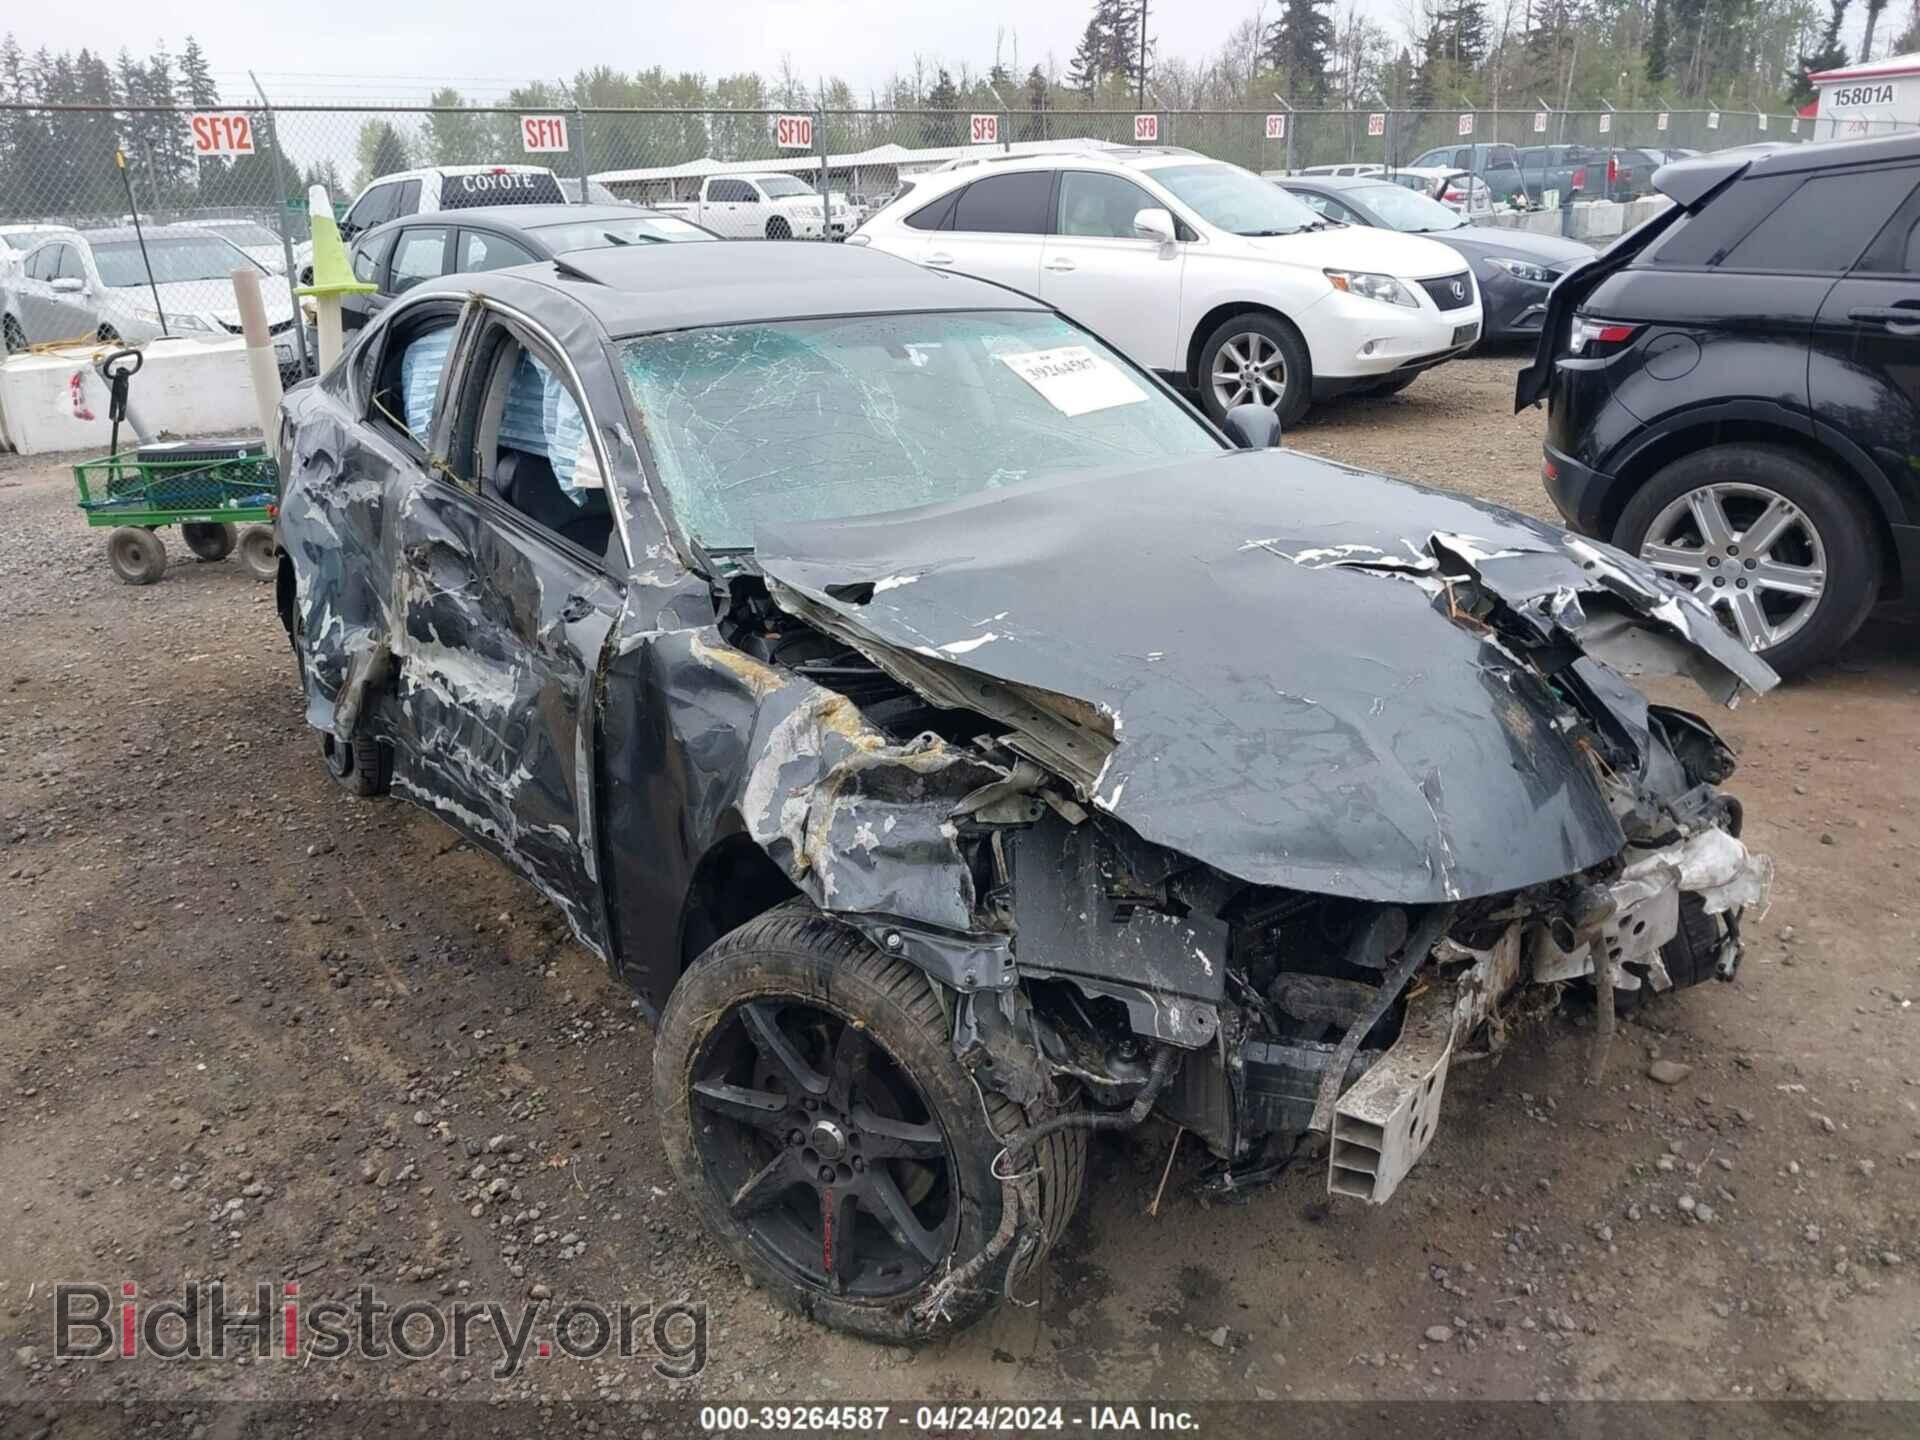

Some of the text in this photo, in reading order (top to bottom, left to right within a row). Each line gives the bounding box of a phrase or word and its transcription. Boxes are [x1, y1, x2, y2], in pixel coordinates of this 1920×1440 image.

[1833, 85, 1894, 106] 15801A
[192, 115, 252, 151] SF12
[525, 119, 563, 148] SF11
[778, 118, 811, 144] SF10
[973, 117, 997, 140] SF9
[1136, 117, 1156, 137] SF8
[1268, 115, 1284, 136] SF7
[462, 172, 535, 192] COYOTE
